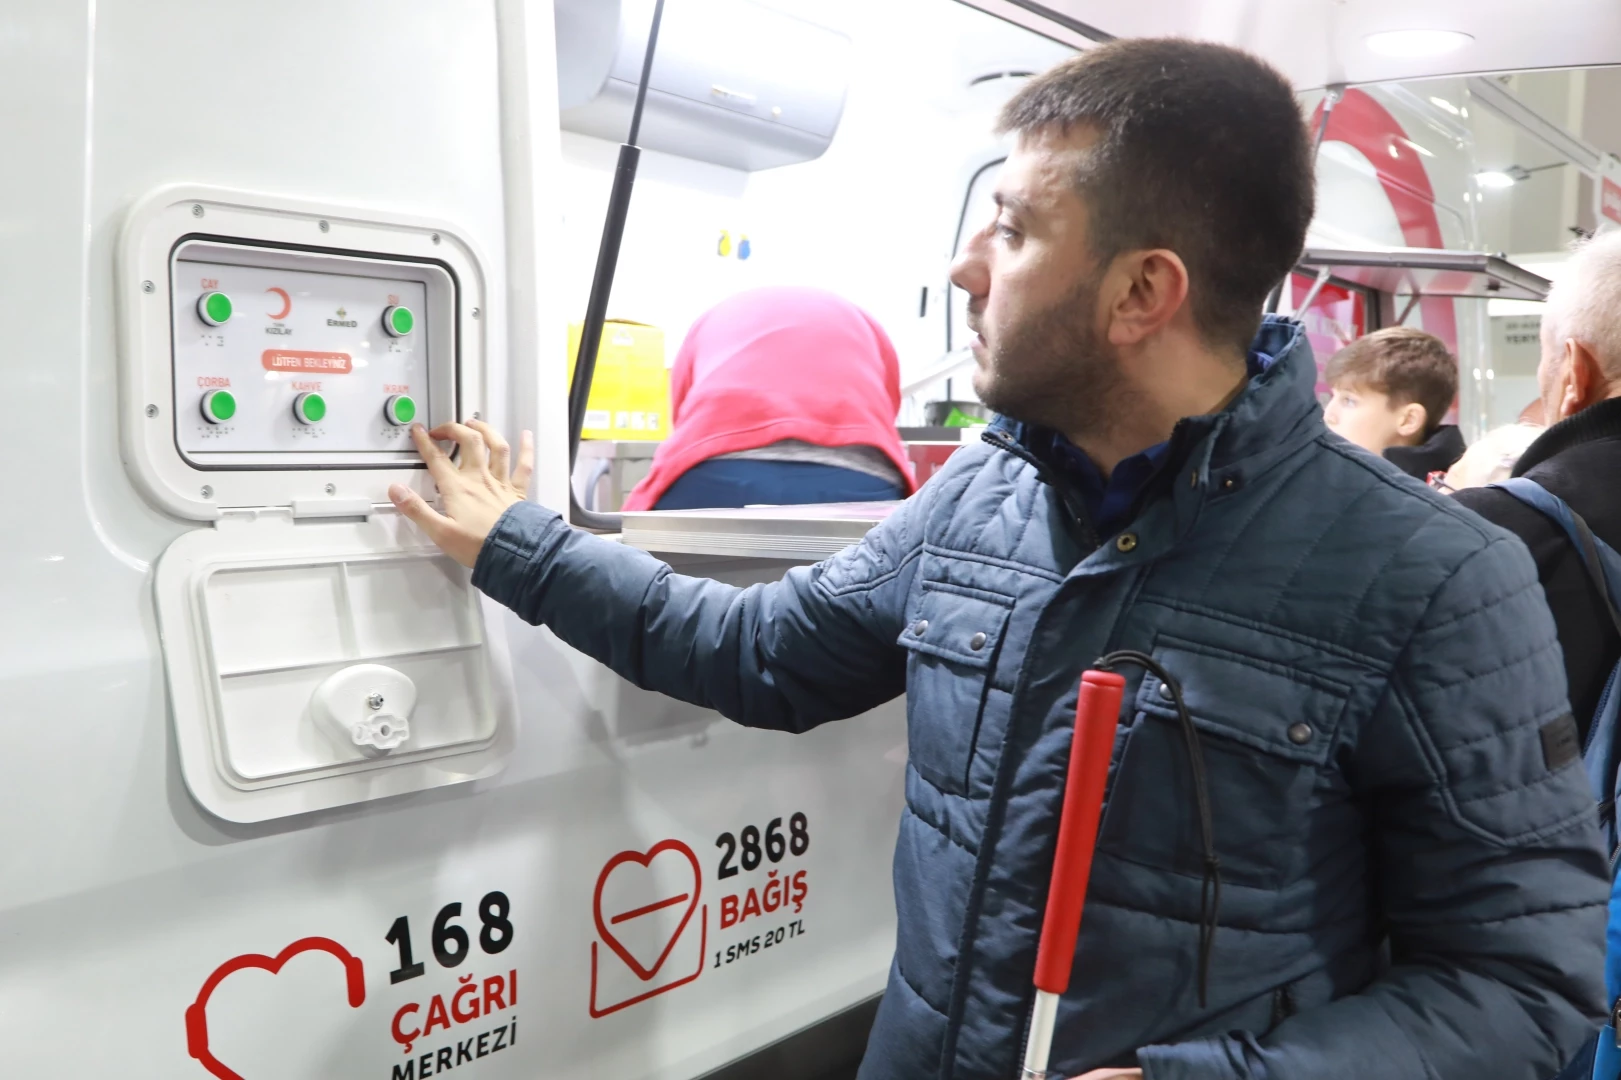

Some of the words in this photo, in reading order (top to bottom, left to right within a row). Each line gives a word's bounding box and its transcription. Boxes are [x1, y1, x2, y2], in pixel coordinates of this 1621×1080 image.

[327, 319, 357, 328] ERMED
[272, 354, 301, 367] LÜTFEN
[291, 381, 322, 391] KAHVE
[715, 812, 809, 880] 2868
[720, 870, 808, 930] BAĞIŞ
[385, 890, 514, 985] 168
[713, 951, 721, 969] 1
[725, 936, 760, 964] SMS
[764, 926, 785, 949] 20
[789, 919, 805, 939] TL
[391, 968, 517, 1055] ÇAĞRI
[392, 1015, 517, 1080] MERKEZİ
